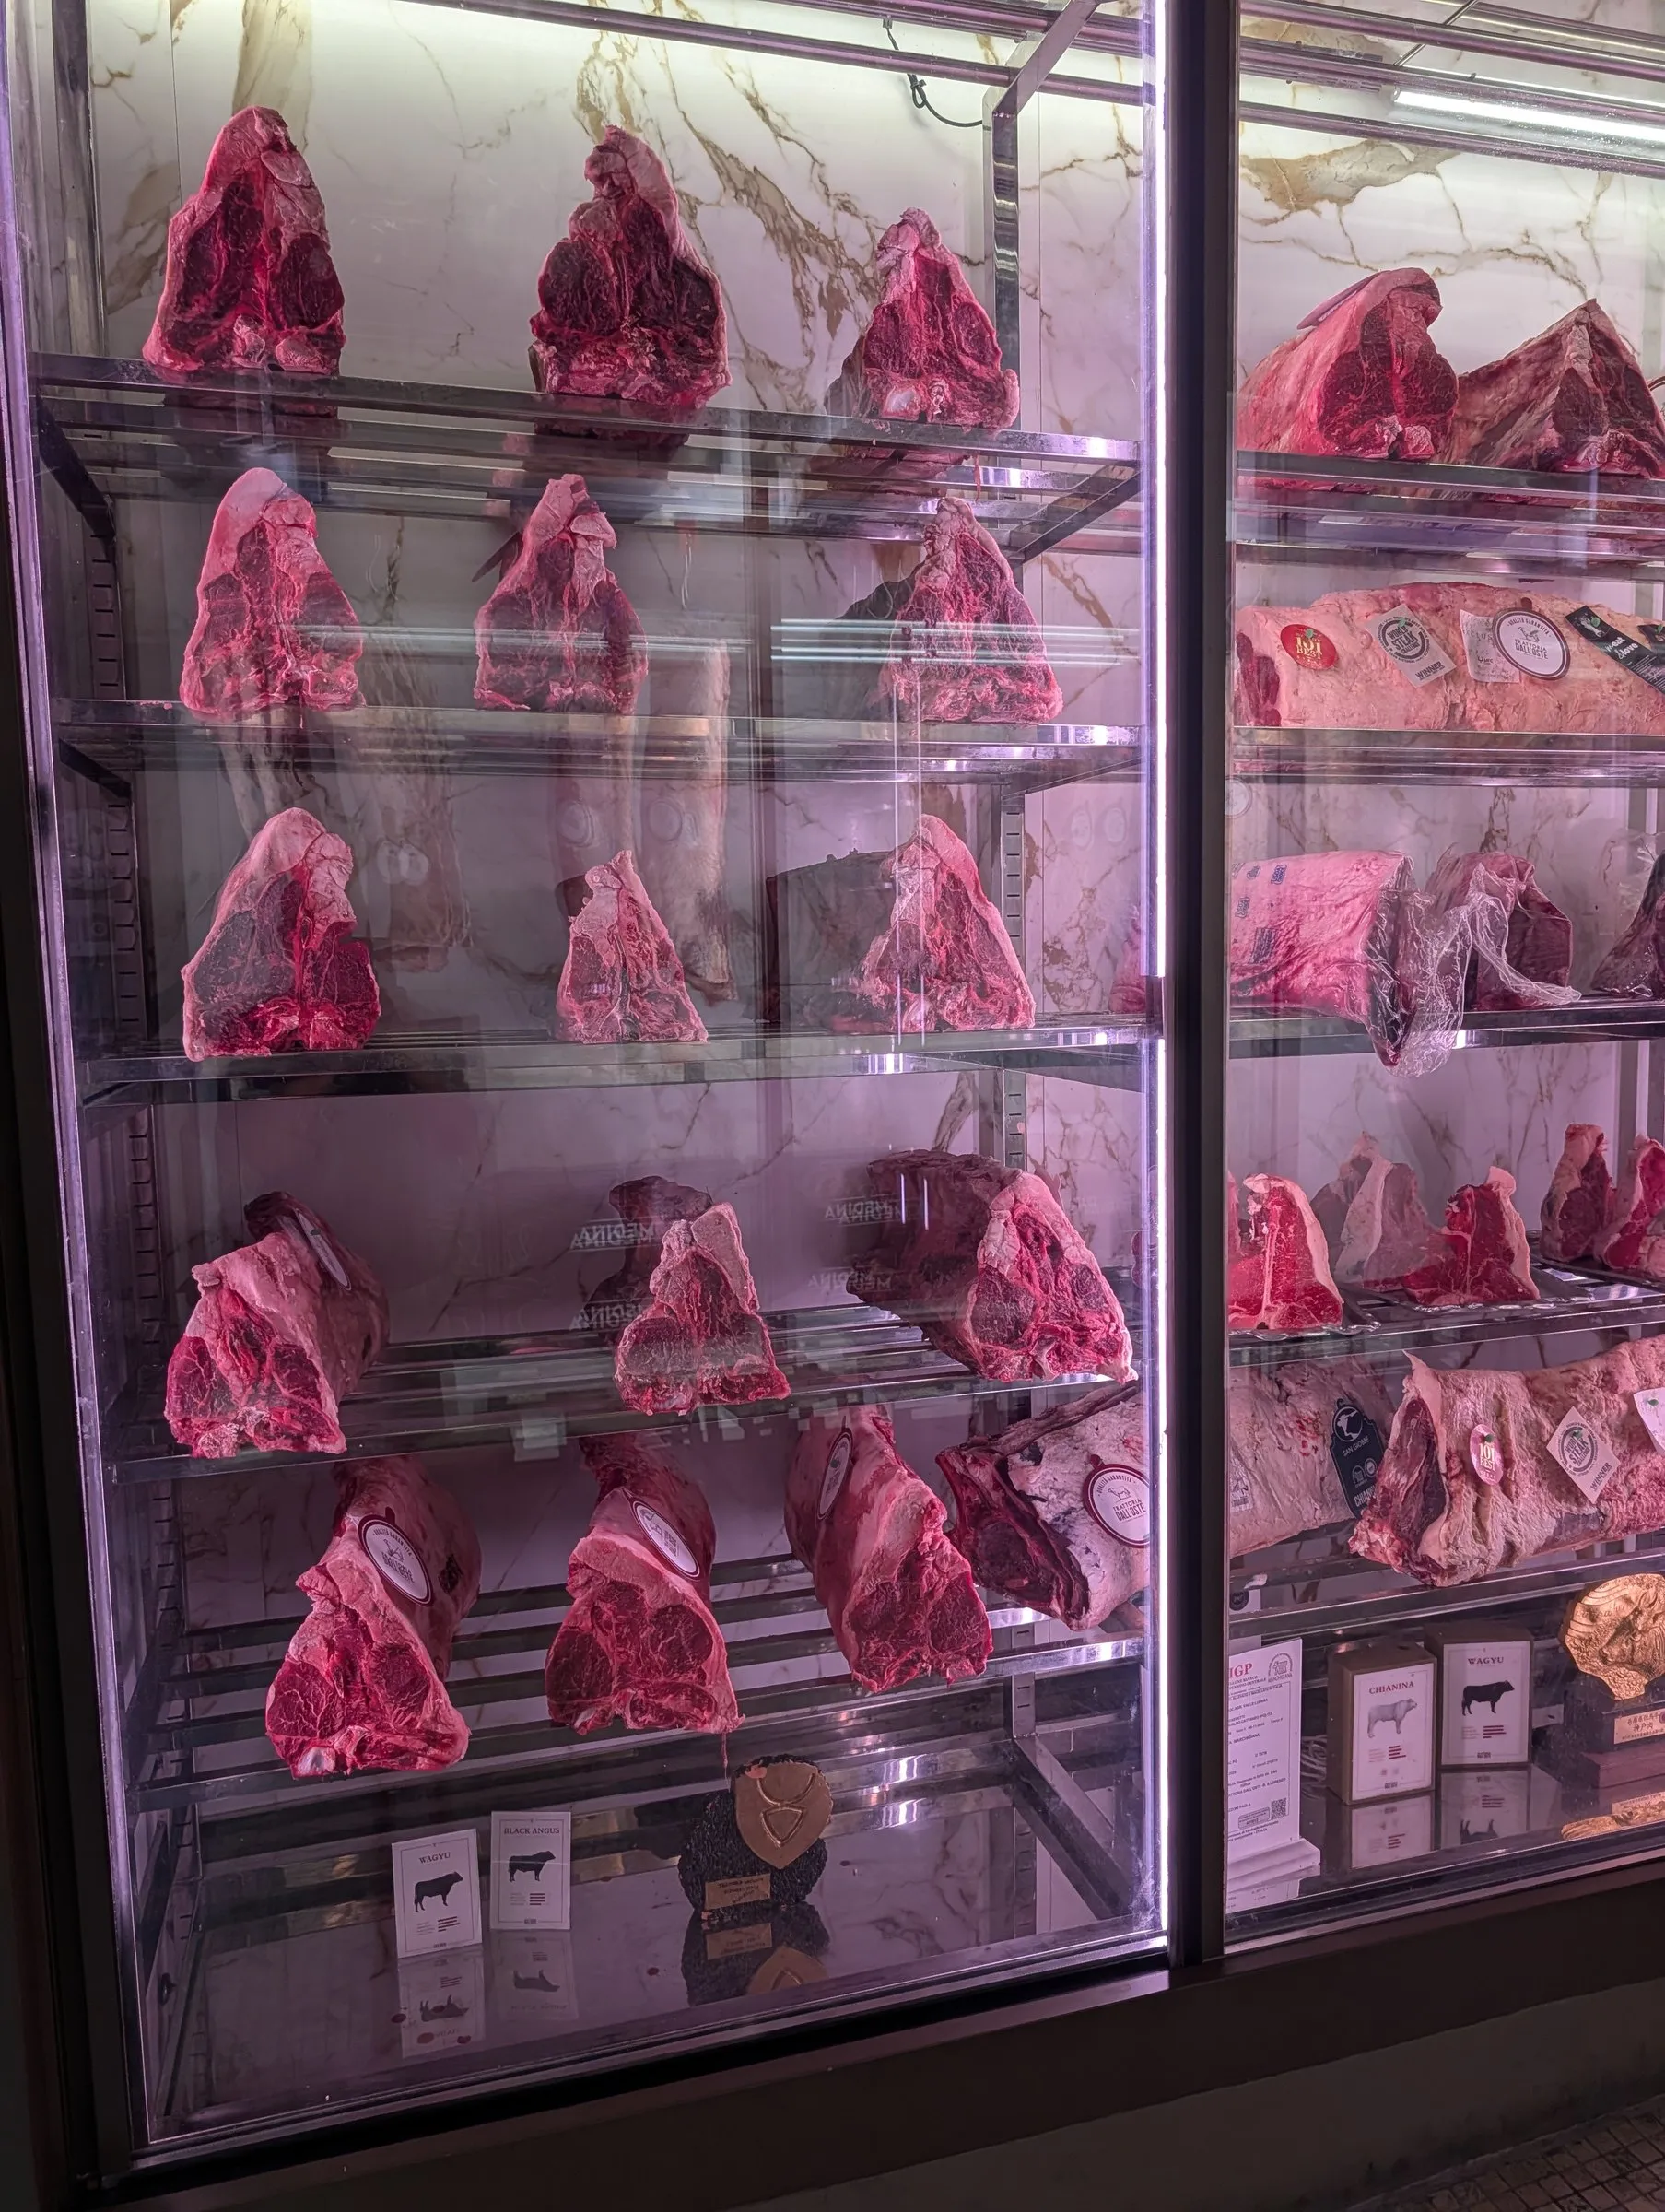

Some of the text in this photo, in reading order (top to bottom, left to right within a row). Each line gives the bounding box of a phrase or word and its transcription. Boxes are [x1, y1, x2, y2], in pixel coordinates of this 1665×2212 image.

[1386, 626, 1409, 640] WORLD
[1391, 631, 1419, 651] STEAK
[1515, 638, 1547, 652] TRATTORIA
[1604, 636, 1626, 653] meat
[1296, 644, 1323, 660] BEST
[1515, 643, 1549, 659] DALL'OSTE
[1415, 661, 1444, 679] WINNER
[1479, 1442, 1495, 1462] 101
[1569, 1437, 1589, 1465] STEAK
[1480, 1457, 1495, 1472] BEST
[1589, 1462, 1612, 1490] WINNER
[1112, 1498, 1143, 1512] TRATTORIA
[1115, 1502, 1146, 1522] DALL'OSTE
[1467, 1656, 1505, 1665] WAGYU
[1229, 1663, 1253, 1678] IGP
[1368, 1680, 1415, 1695] CHIANINA
[504, 1827, 560, 1835] BLACK ANGUS
[418, 1852, 451, 1864] WAGYU
